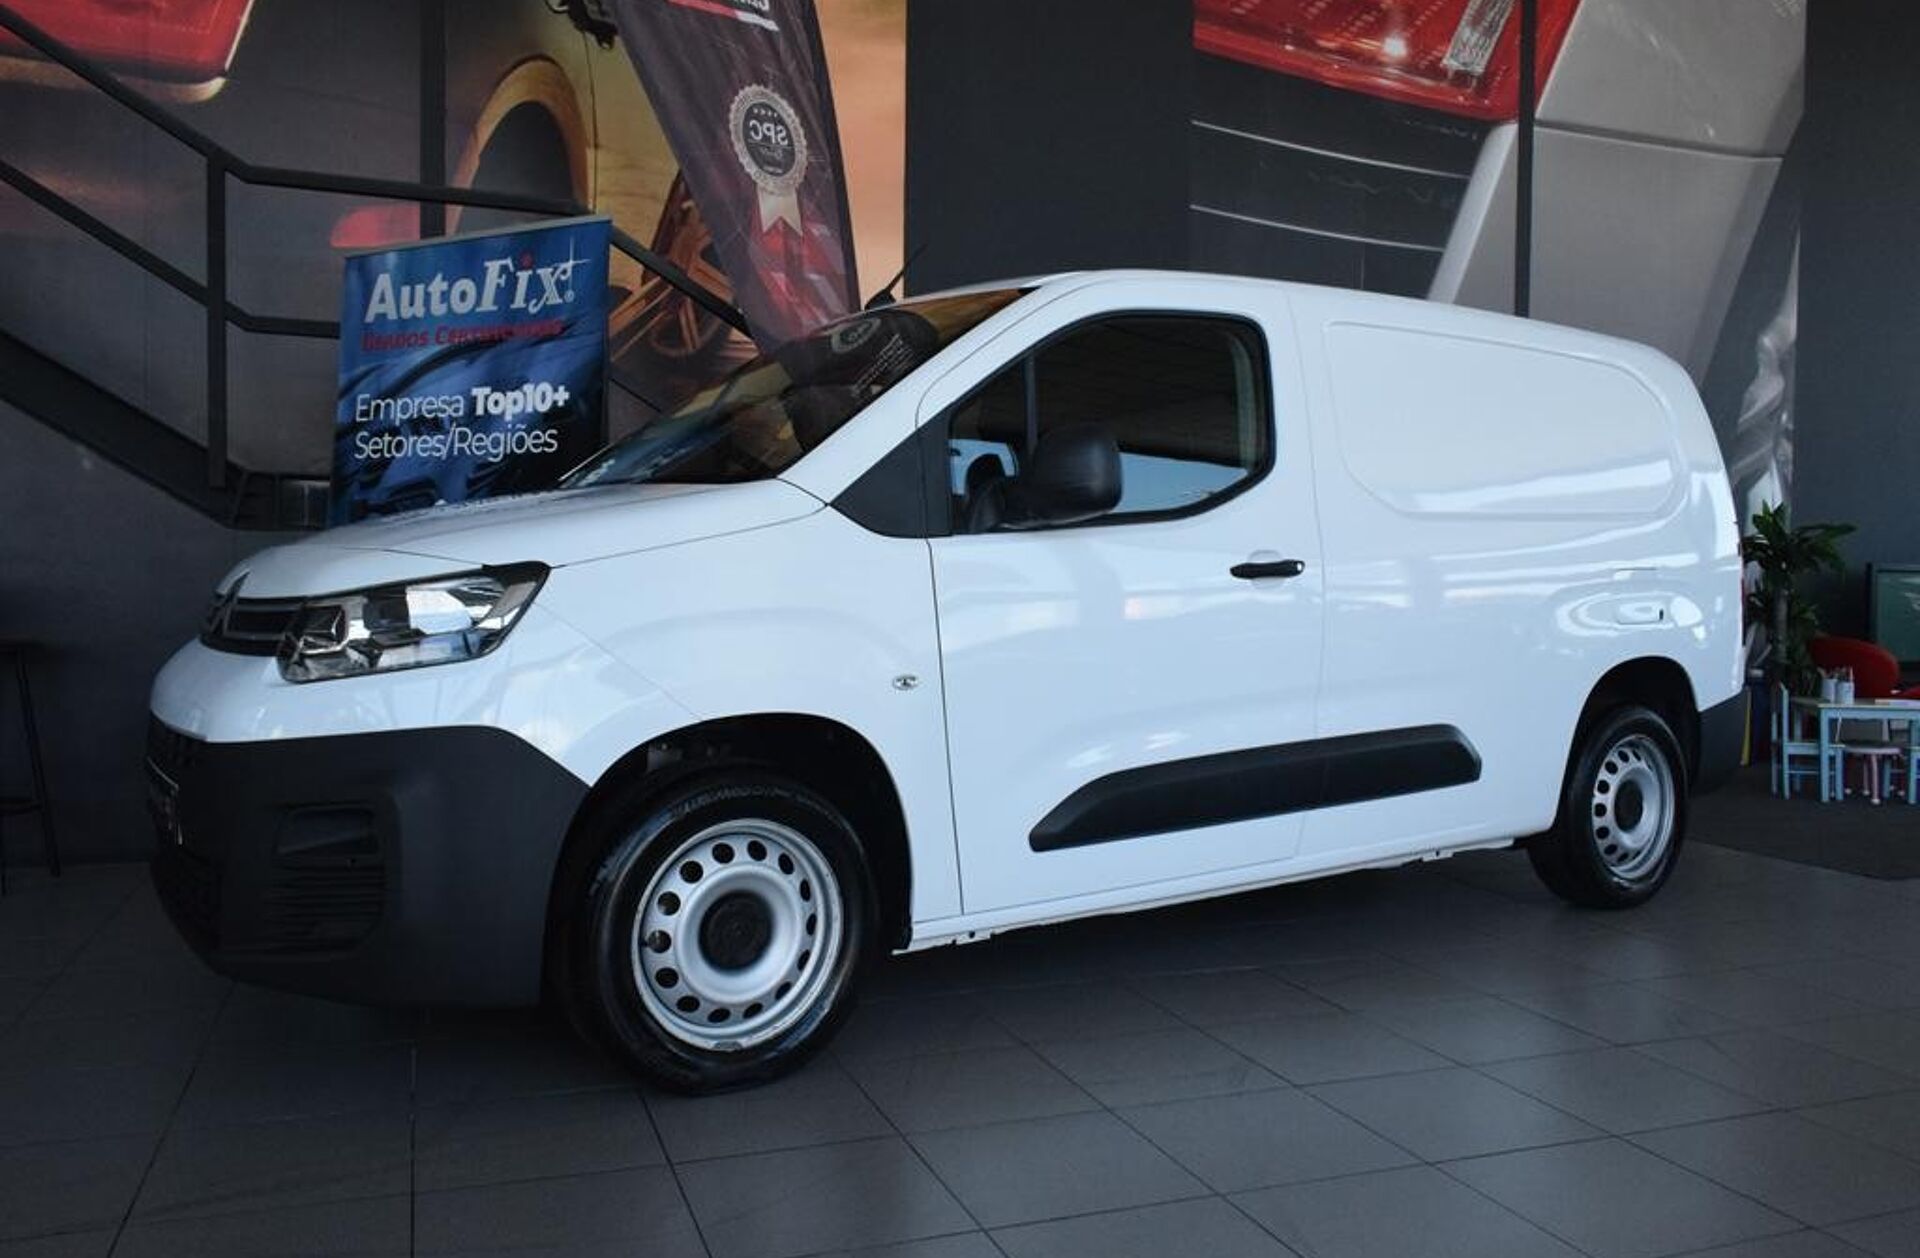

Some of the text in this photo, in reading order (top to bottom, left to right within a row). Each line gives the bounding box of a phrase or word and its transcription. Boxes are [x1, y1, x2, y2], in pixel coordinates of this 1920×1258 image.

[355, 382, 570, 425] Empresa Top10+
[354, 422, 558, 462] Setores/Regiões
